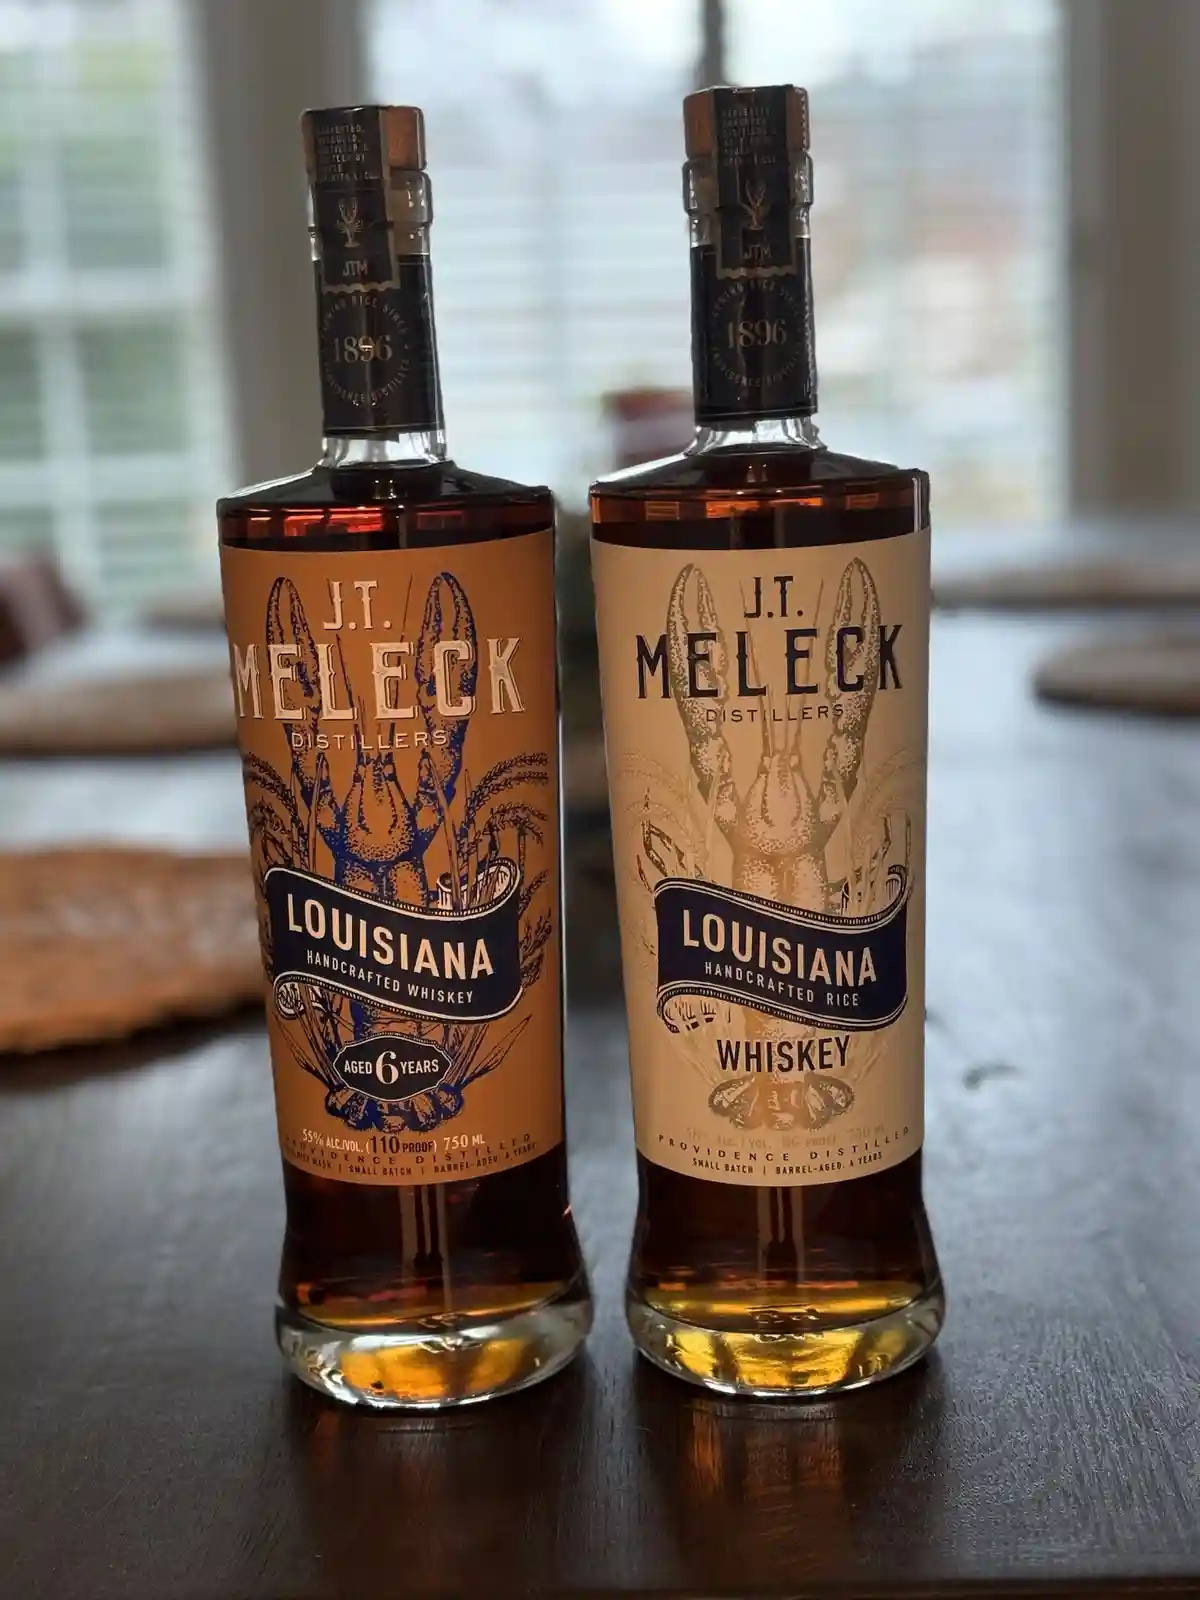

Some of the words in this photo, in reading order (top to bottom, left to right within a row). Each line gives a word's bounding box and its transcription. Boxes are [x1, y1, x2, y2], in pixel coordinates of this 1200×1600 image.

[342, 259, 369, 278] JTM
[332, 334, 394, 364] 1896
[727, 318, 788, 350] 1896
[323, 579, 393, 631] J.T.
[744, 575, 804, 619] J.T.
[232, 637, 526, 722] MELECK
[635, 624, 904, 700] MELECK
[705, 702, 846, 724] DISTILLERS
[291, 728, 448, 752] DISTILLERS
[286, 892, 495, 981] LOUISIANA
[682, 908, 878, 988] LOUISIANA
[305, 948, 400, 993] HANDCRAFTED
[407, 984, 474, 1005] WHISKEY
[704, 960, 815, 1003] HANDCRAFTED
[826, 992, 860, 1007] RICE
[344, 1059, 373, 1075] AGED
[375, 1050, 400, 1085] 6
[400, 1058, 440, 1075] YEARS
[716, 1034, 851, 1074] WHISKEY
[414, 1132, 532, 1166] DISTILLED
[443, 1133, 469, 1151] 750
[471, 1133, 486, 1146] ML
[658, 1133, 789, 1163] PROVIDENCE
[809, 1125, 910, 1161] DISTILLED
[348, 1164, 383, 1177] SMALL
[382, 1167, 413, 1177] BATCH
[692, 1156, 721, 1172] SMALL
[724, 1162, 754, 1175] BATCH
[857, 1150, 884, 1168] YEARS
